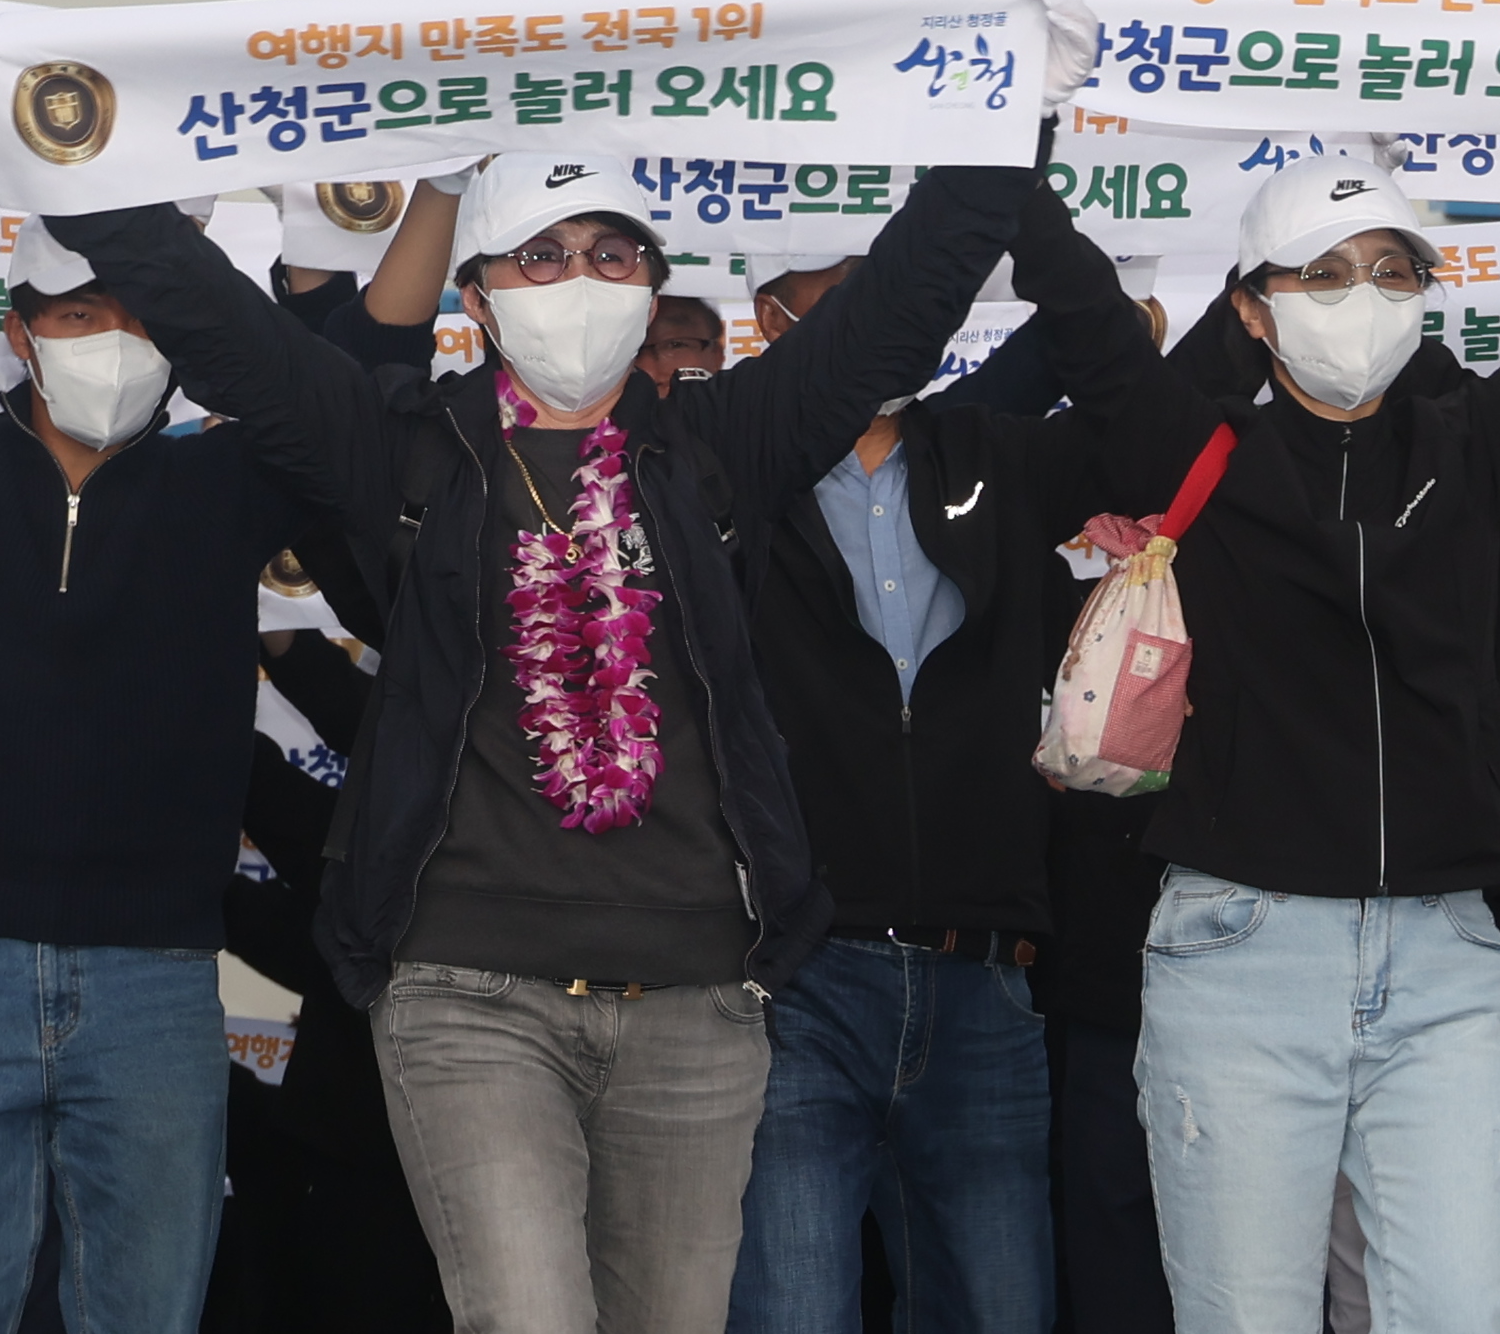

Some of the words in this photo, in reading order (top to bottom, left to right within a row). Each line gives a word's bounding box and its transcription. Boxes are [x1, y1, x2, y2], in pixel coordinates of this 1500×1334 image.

[245, 21, 405, 69] 여행지
[420, 15, 567, 63] 만족도
[581, 6, 678, 53] 전국
[692, 2, 764, 42] 1위
[921, 15, 962, 29] 지리산
[1358, 33, 1475, 100] 놀러
[178, 76, 493, 162] 산청군으로
[510, 69, 633, 126] 놀러
[650, 61, 838, 123] 오세요
[553, 164, 586, 178] NIKE
[631, 156, 893, 223] 산청군으로
[1336, 179, 1366, 192] NIKE
